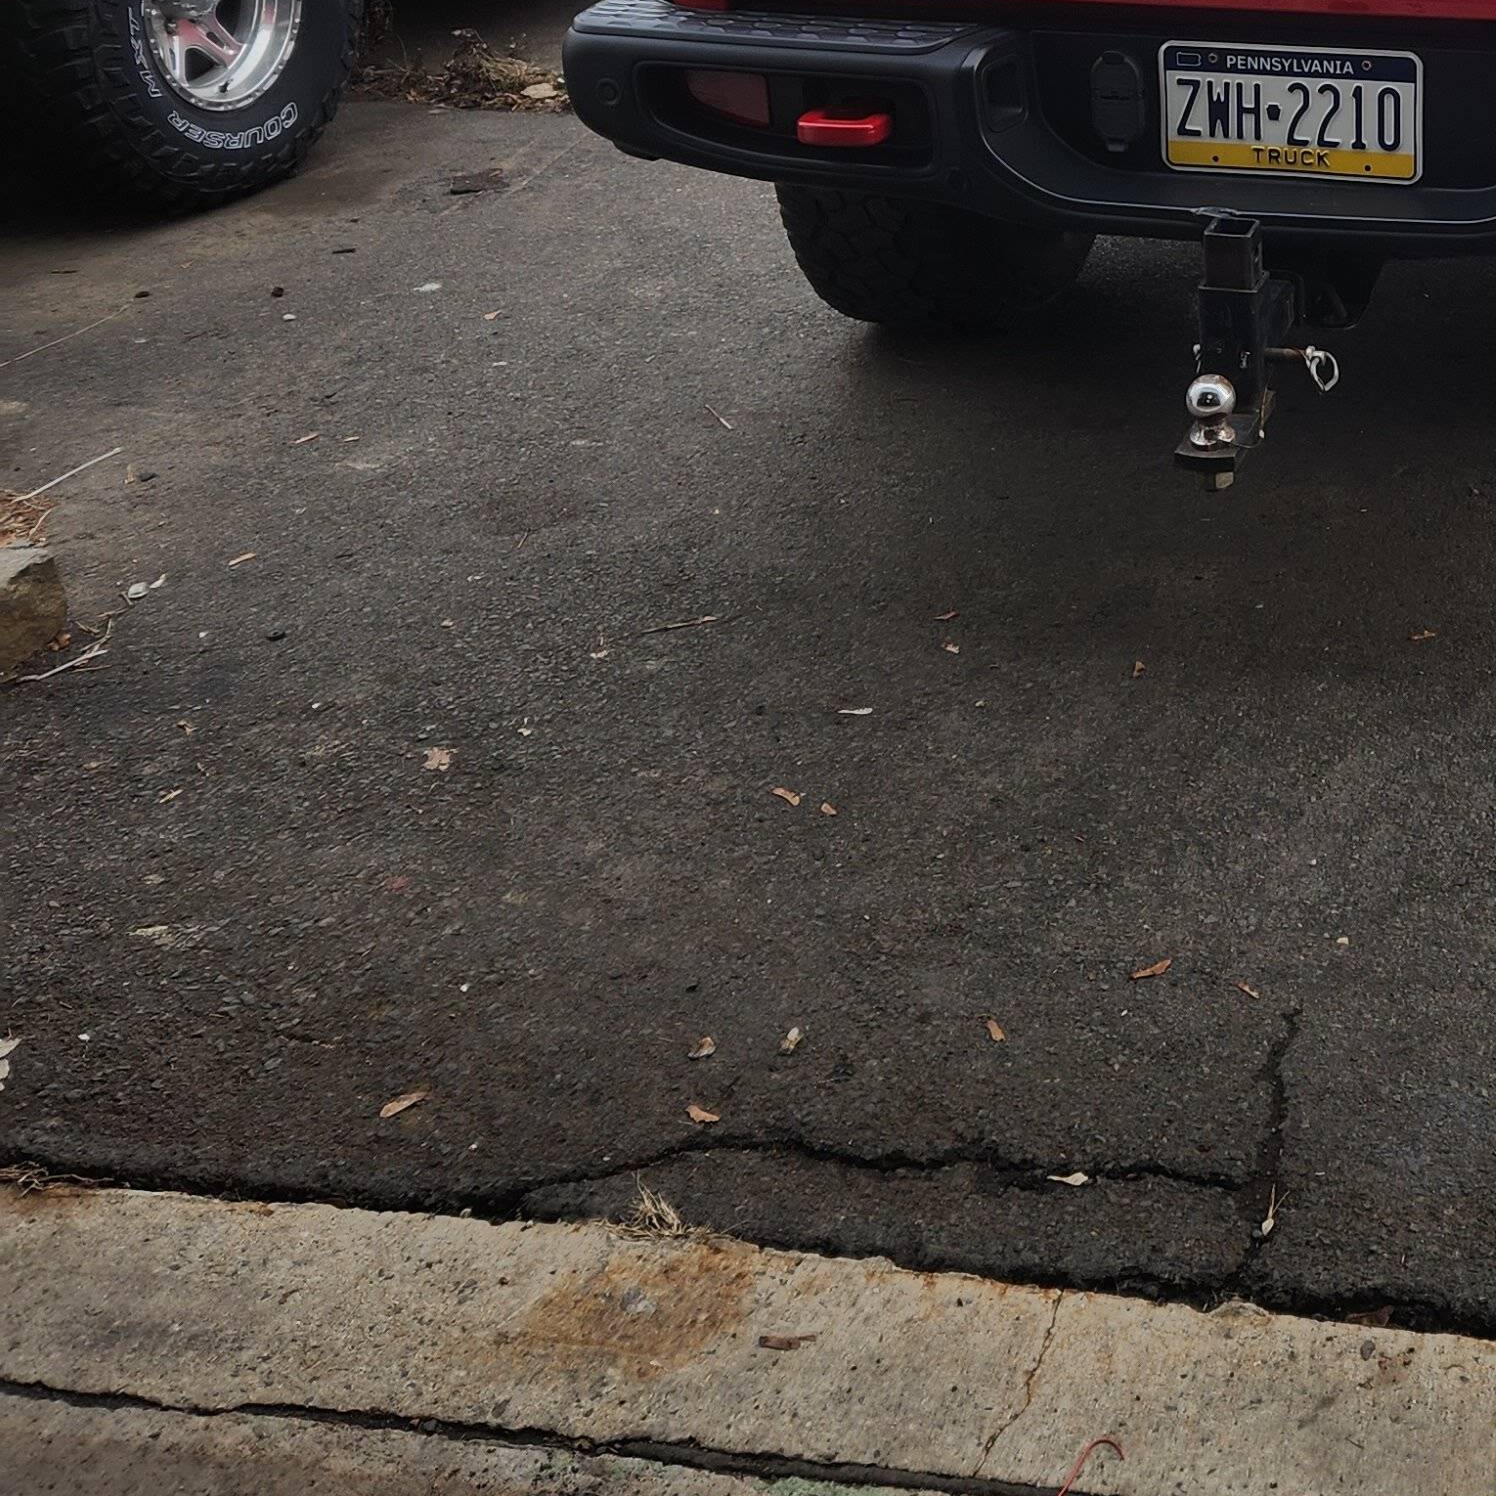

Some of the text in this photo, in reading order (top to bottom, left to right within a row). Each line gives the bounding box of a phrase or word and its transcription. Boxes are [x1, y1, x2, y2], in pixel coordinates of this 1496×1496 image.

[1226, 55, 1355, 75] PENNSYLVANIA
[166, 101, 299, 150] COURSER
[1252, 147, 1330, 167] TRUCK
